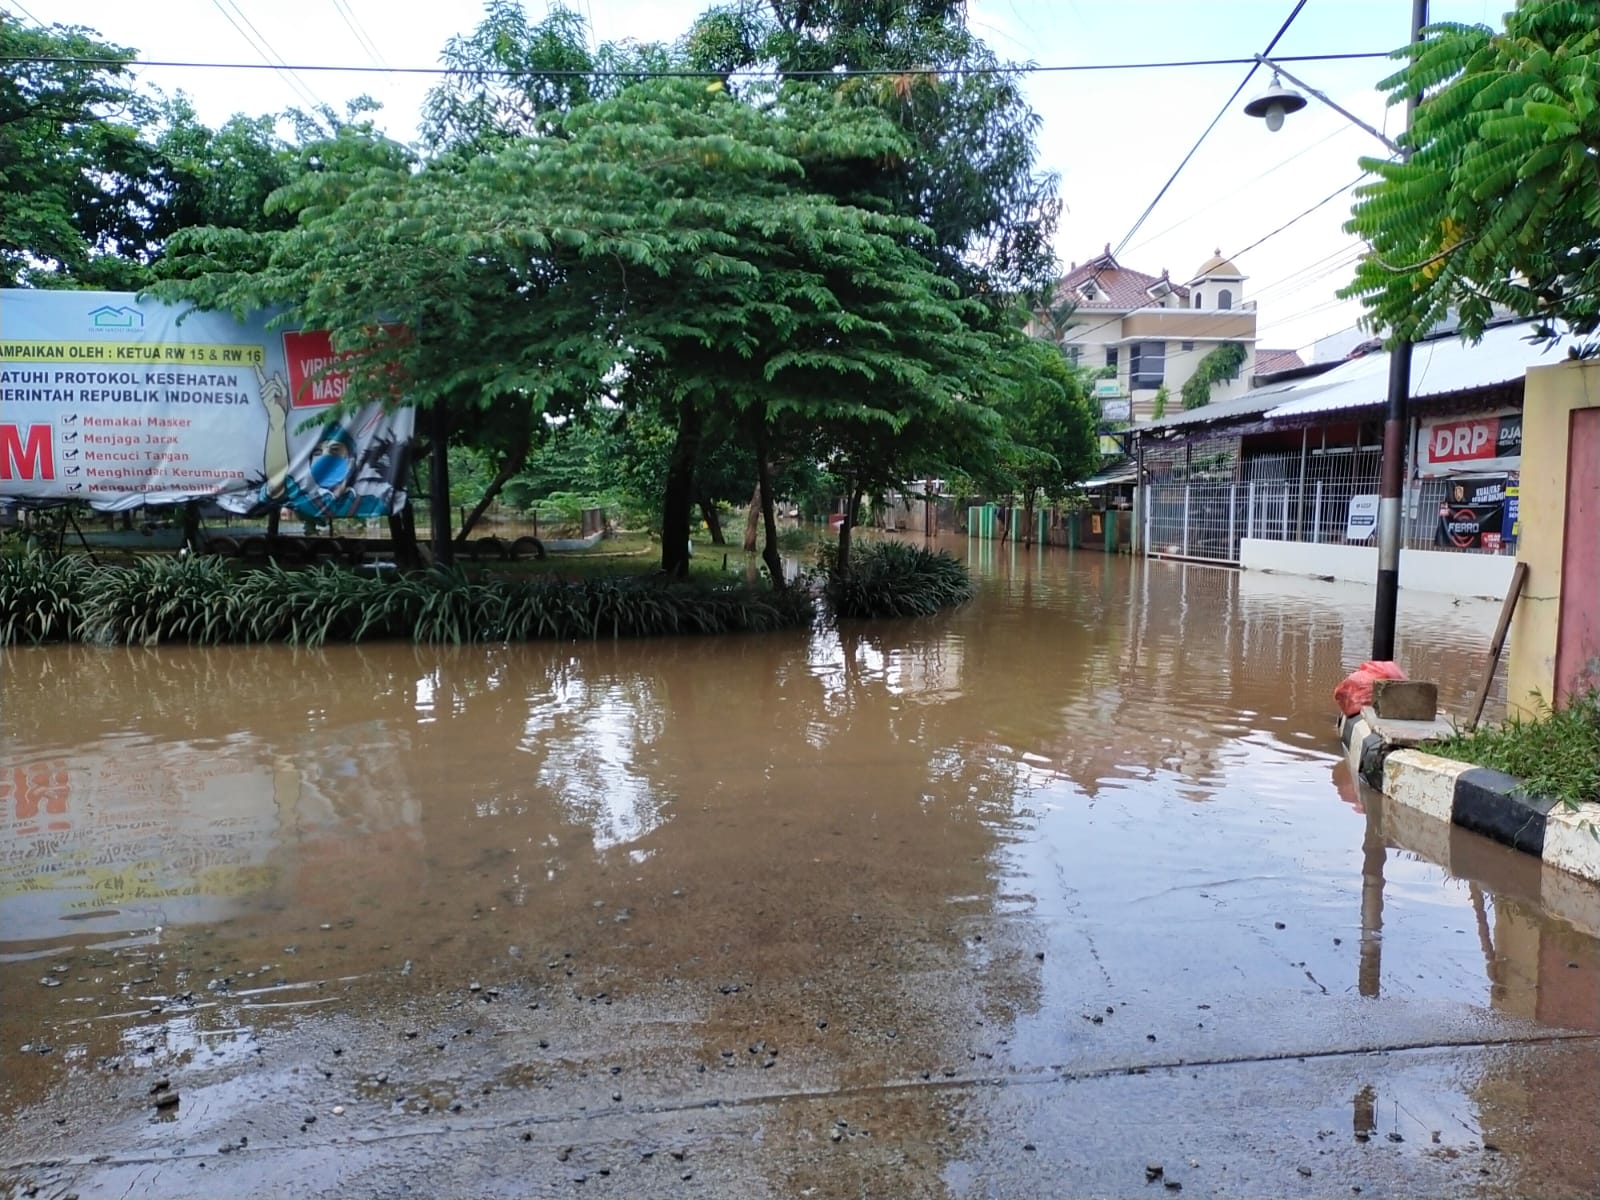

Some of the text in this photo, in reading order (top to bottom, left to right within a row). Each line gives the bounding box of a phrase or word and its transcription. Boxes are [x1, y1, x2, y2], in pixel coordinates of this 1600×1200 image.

[68, 346, 104, 358] OLEH
[117, 347, 160, 359] KETUA
[165, 347, 186, 360] RW
[190, 348, 204, 361] 15
[208, 349, 218, 361] &
[223, 350, 243, 361] RW
[247, 350, 261, 361] 16
[0, 371, 238, 386] ATUHI PROTOKOL KESEHATAN
[312, 377, 350, 400] MASI
[0, 389, 249, 405] ERINTAH REPUBLIK INDONESIA
[83, 416, 192, 427] Memakai Masker
[84, 433, 178, 446] Menjaga Jarak
[1435, 425, 1488, 457] DRP
[85, 451, 139, 461] Mencuci
[86, 466, 245, 478] Menghindari Kerumunan
[1448, 522, 1479, 533] FERRO
